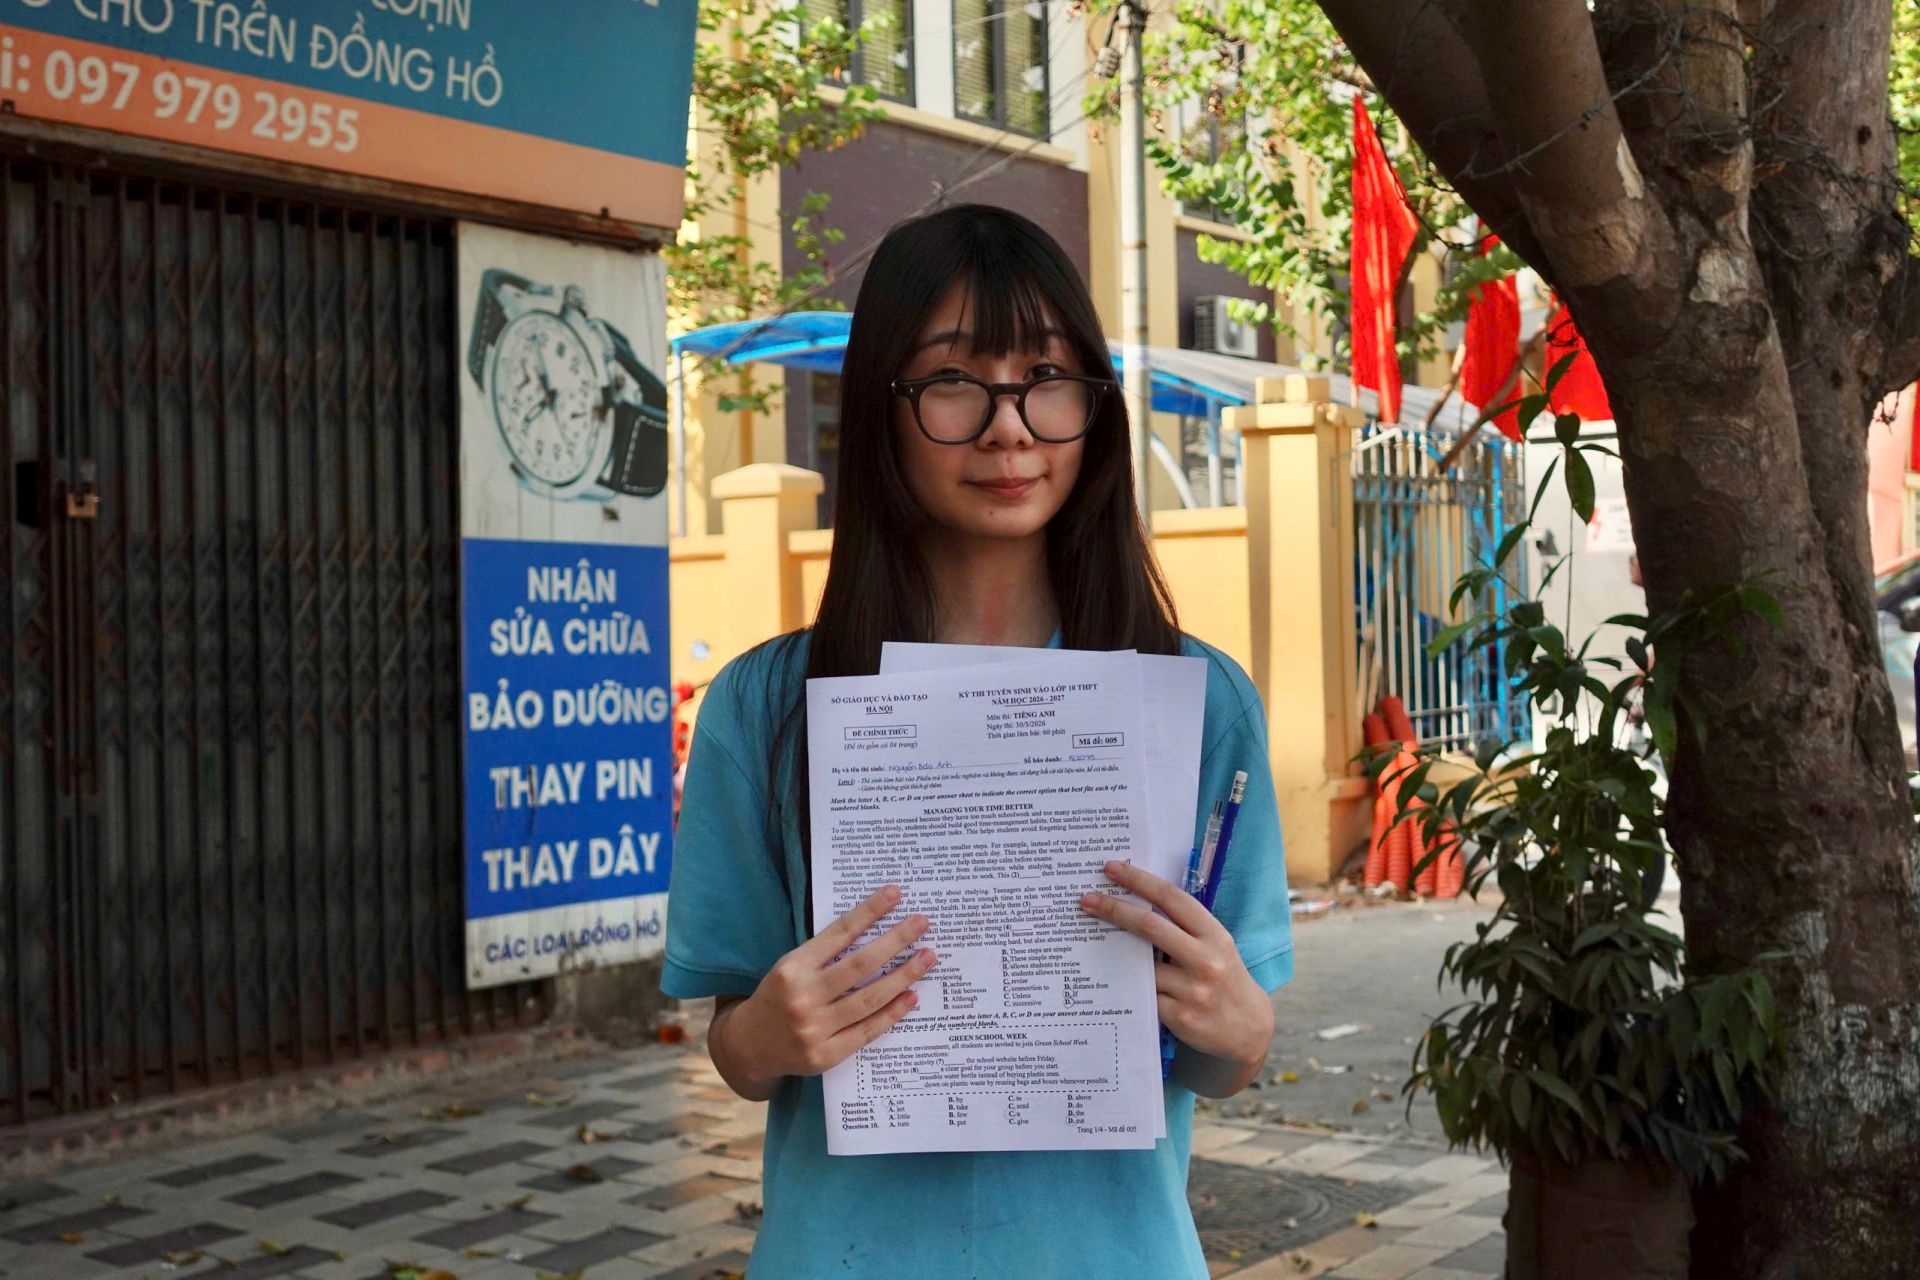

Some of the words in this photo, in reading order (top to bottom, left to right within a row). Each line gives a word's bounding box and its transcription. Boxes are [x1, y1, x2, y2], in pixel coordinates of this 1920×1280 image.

[195, 0, 297, 63] TRÊN
[310, 11, 434, 92] ĐỒNG
[446, 42, 502, 108] HỒ
[44, 50, 140, 110] 097
[152, 70, 241, 130] 979
[251, 91, 360, 152] 2955
[527, 557, 617, 613] NHẬN
[490, 606, 555, 656] SỬA
[562, 611, 651, 655] CHỮA
[842, 694, 861, 703] GIÁO
[863, 695, 878, 703] DỤC
[893, 693, 909, 701] ĐÀO
[912, 694, 927, 702] TẠO
[971, 690, 984, 698] THI
[986, 687, 1011, 697] TUYỂN
[1013, 687, 1031, 695] SINH
[1033, 685, 1049, 694] VÀO
[1051, 684, 1066, 693] LỚP
[1078, 683, 1097, 691] THPT
[469, 677, 544, 731] BẢO
[553, 679, 669, 727] DƯỠNG
[1010, 697, 1026, 705] HỌC
[1049, 694, 1064, 702] 2027
[878, 704, 893, 713] NỘI
[1014, 709, 1037, 719] TIẾNG
[863, 727, 886, 736] CHÍNH
[888, 726, 908, 735] THỨC
[489, 762, 586, 809] THAY
[596, 757, 652, 801] PIN
[1038, 787, 1056, 796] option
[924, 806, 962, 814] MANAGING
[839, 819, 854, 827] Many
[856, 818, 882, 826] teenagers
[941, 814, 954, 822] they
[482, 840, 579, 892] THAY
[589, 823, 661, 879] DÂY
[485, 934, 526, 963] CÁC
[580, 916, 630, 948] ĐỒNG
[636, 910, 661, 938] HỒ
